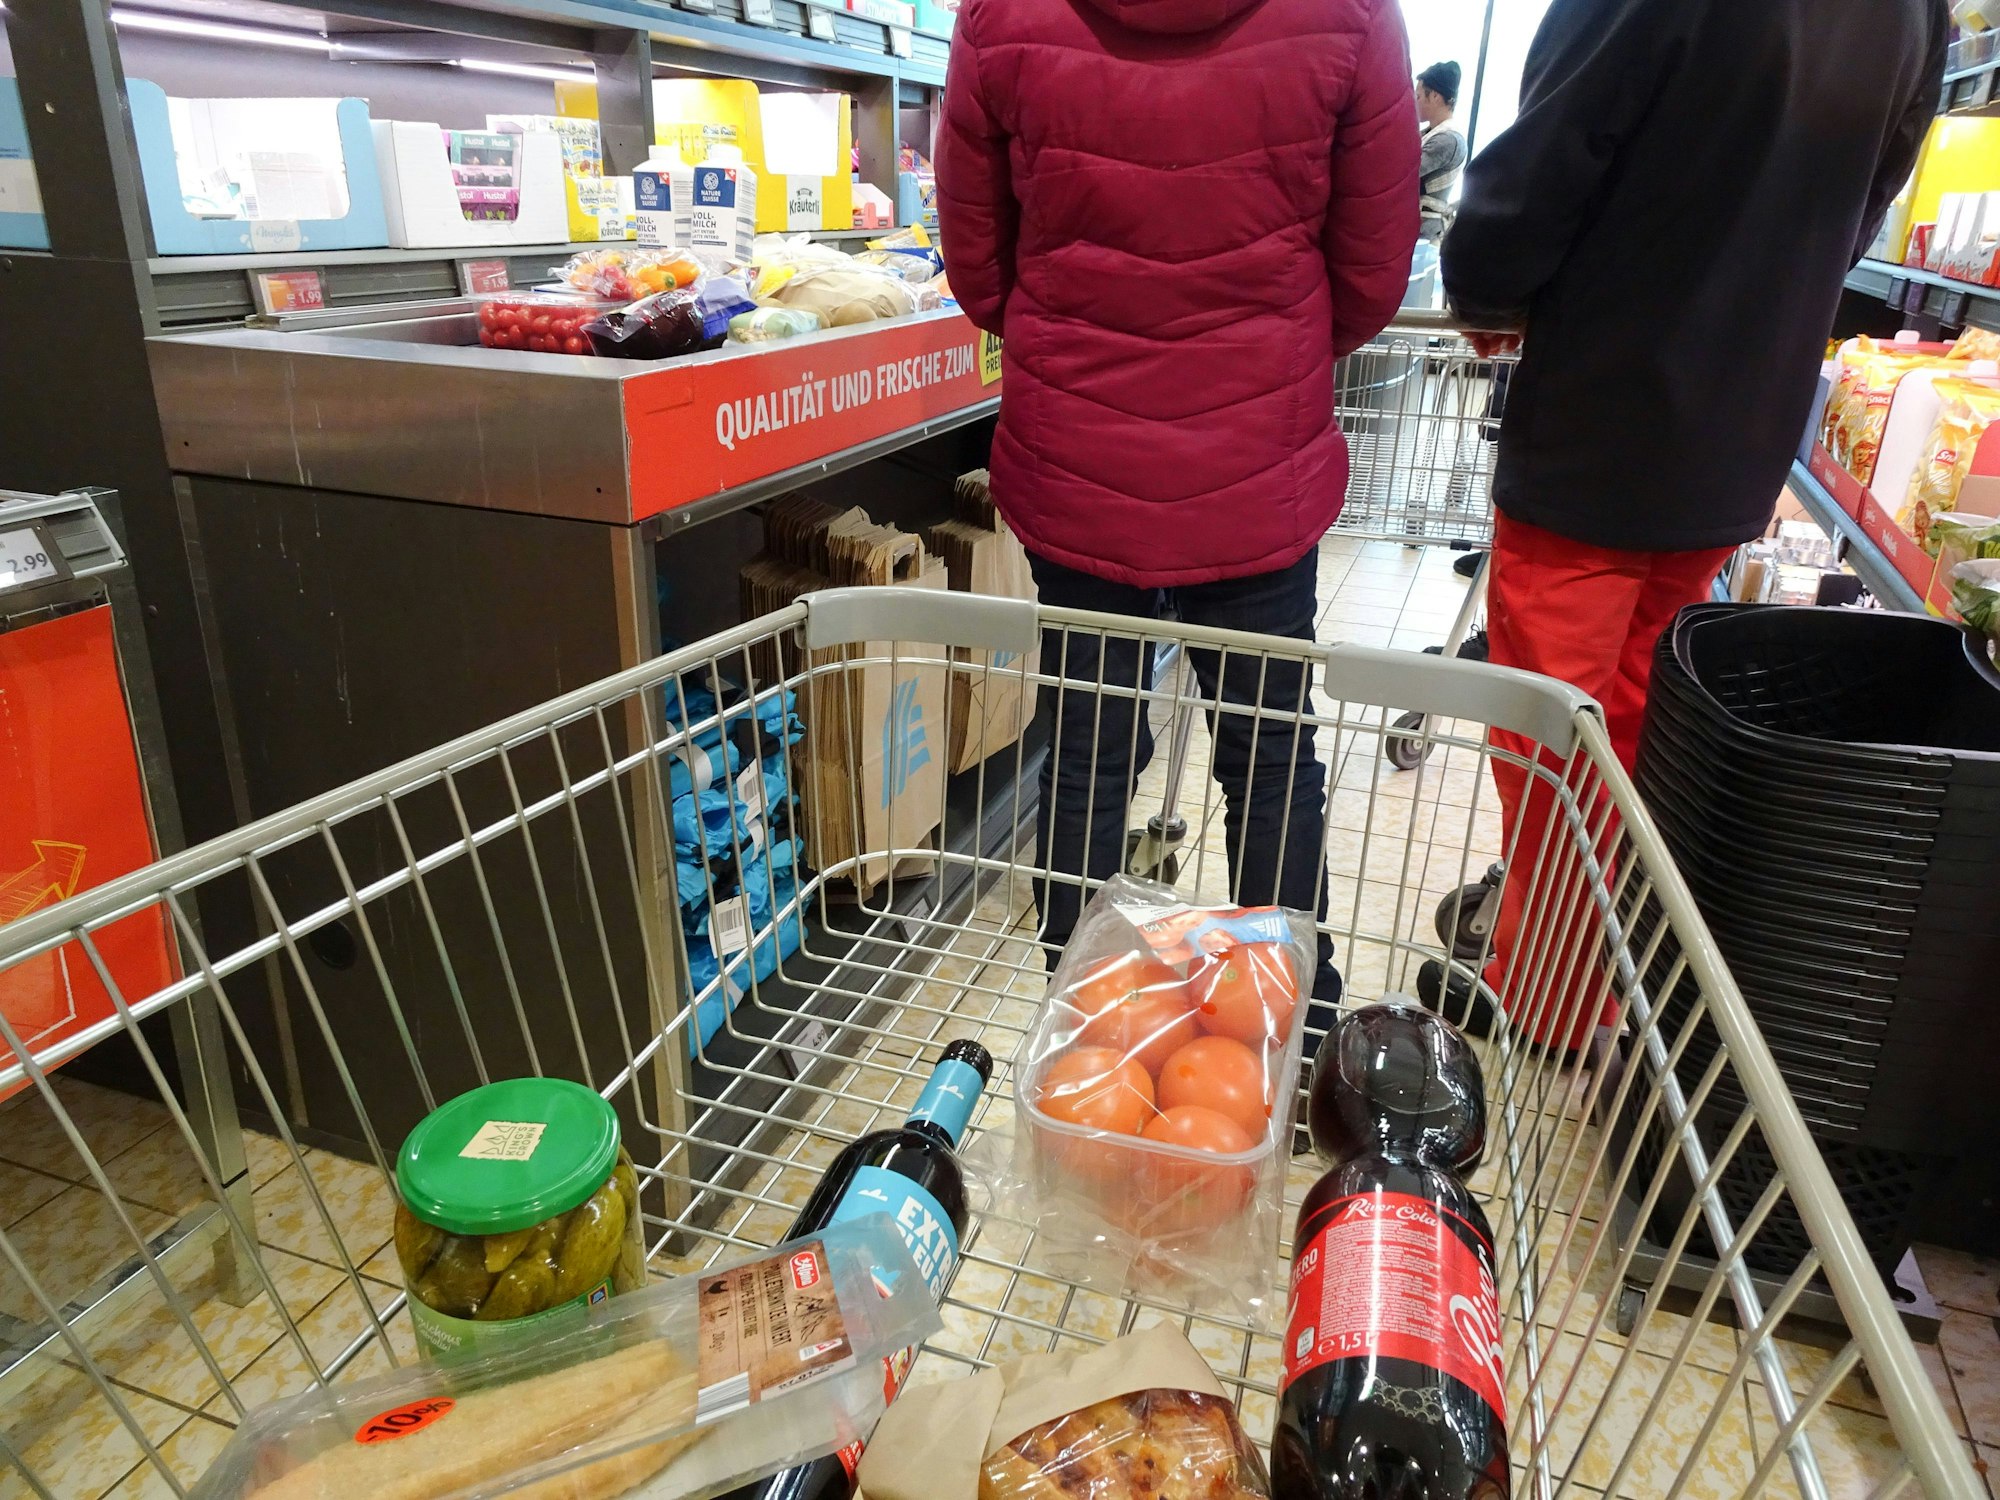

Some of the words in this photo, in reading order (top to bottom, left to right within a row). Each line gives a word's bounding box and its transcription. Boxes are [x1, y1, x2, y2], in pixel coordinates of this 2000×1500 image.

[464, 136, 485, 146] Hustol
[491, 138, 510, 148] Hustol
[460, 190, 474, 200] stol
[484, 190, 506, 200] Hustol
[692, 212, 715, 220] VOLL-
[789, 197, 820, 216] Kräuterli
[636, 216, 654, 224] VOLL-
[636, 224, 656, 232] MILCH
[692, 220, 717, 228] MILCH
[491, 277, 508, 288] 1.99
[298, 290, 322, 304] 1.99
[986, 354, 1000, 375] PREI
[715, 370, 827, 451] QUALITÄT
[831, 369, 872, 413] UND
[876, 351, 941, 400] FRISCHE
[944, 343, 974, 380] ZUM
[6, 552, 48, 574] 2.99
[506, 1125, 529, 1156] KING'S
[516, 1125, 537, 1156] CROWN
[1344, 1198, 1394, 1220] River
[1395, 1205, 1438, 1227] Cola
[896, 1195, 952, 1290] EXTR
[1338, 1332, 1362, 1352] 1,5
